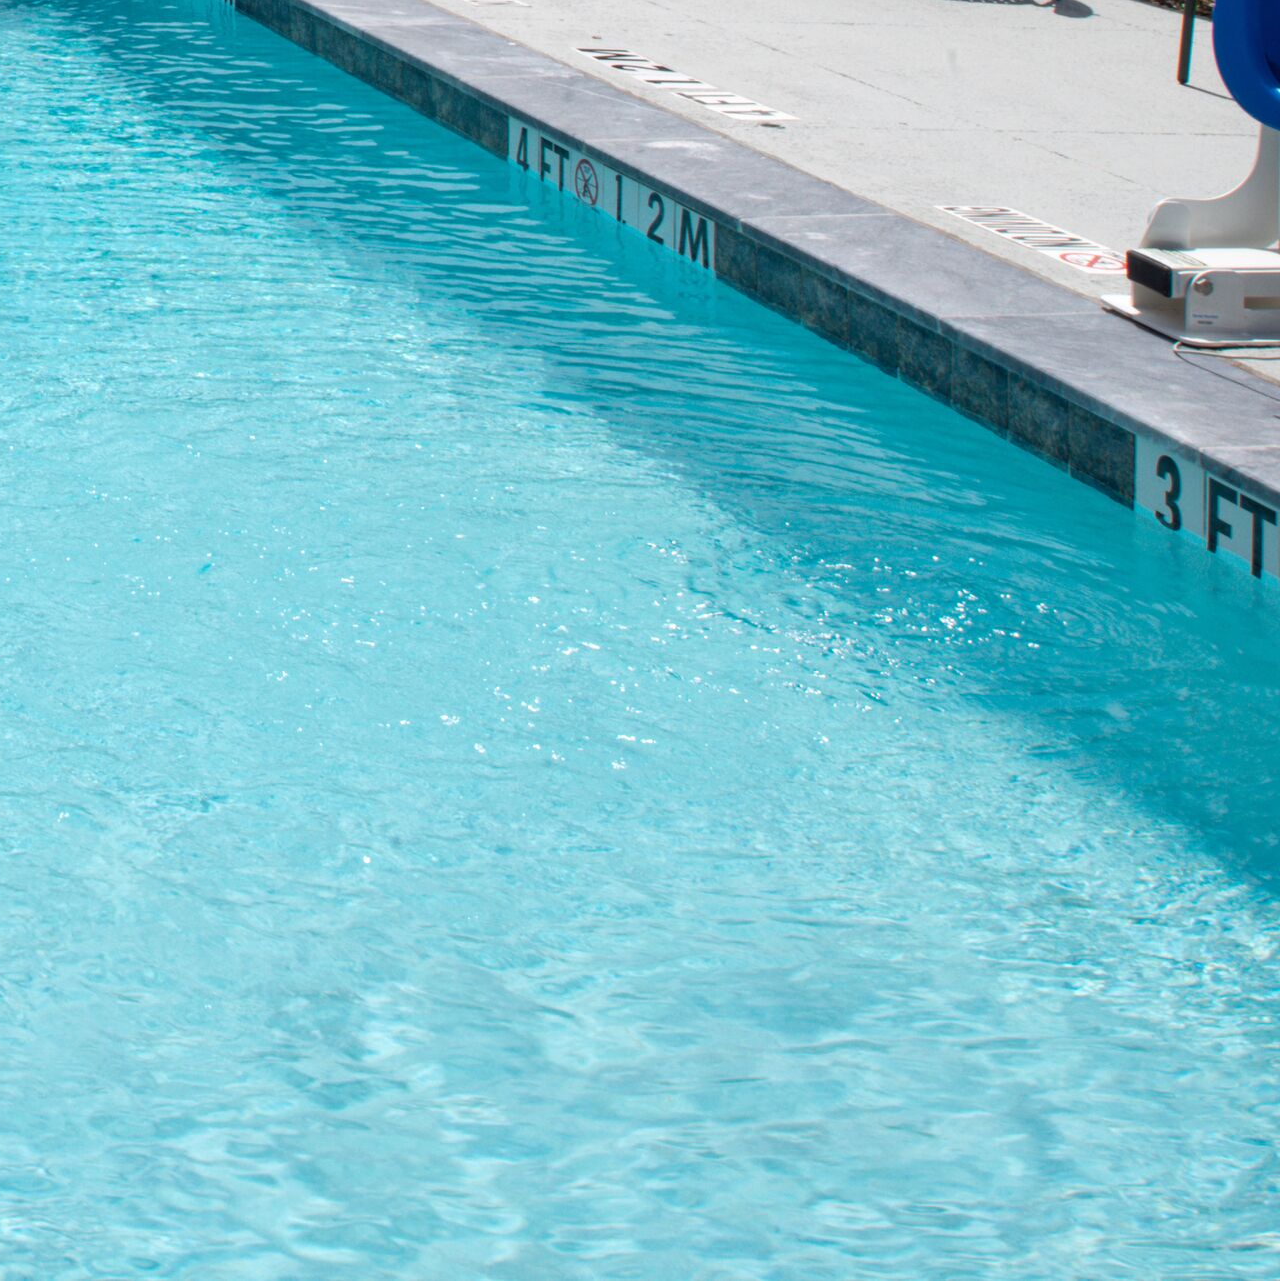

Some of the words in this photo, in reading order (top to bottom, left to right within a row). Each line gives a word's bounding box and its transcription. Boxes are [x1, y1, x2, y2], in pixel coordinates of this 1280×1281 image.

[515, 126, 529, 172] 4
[539, 138, 570, 193] FT
[1154, 454, 1182, 532] 3
[1206, 475, 1278, 580] FT
